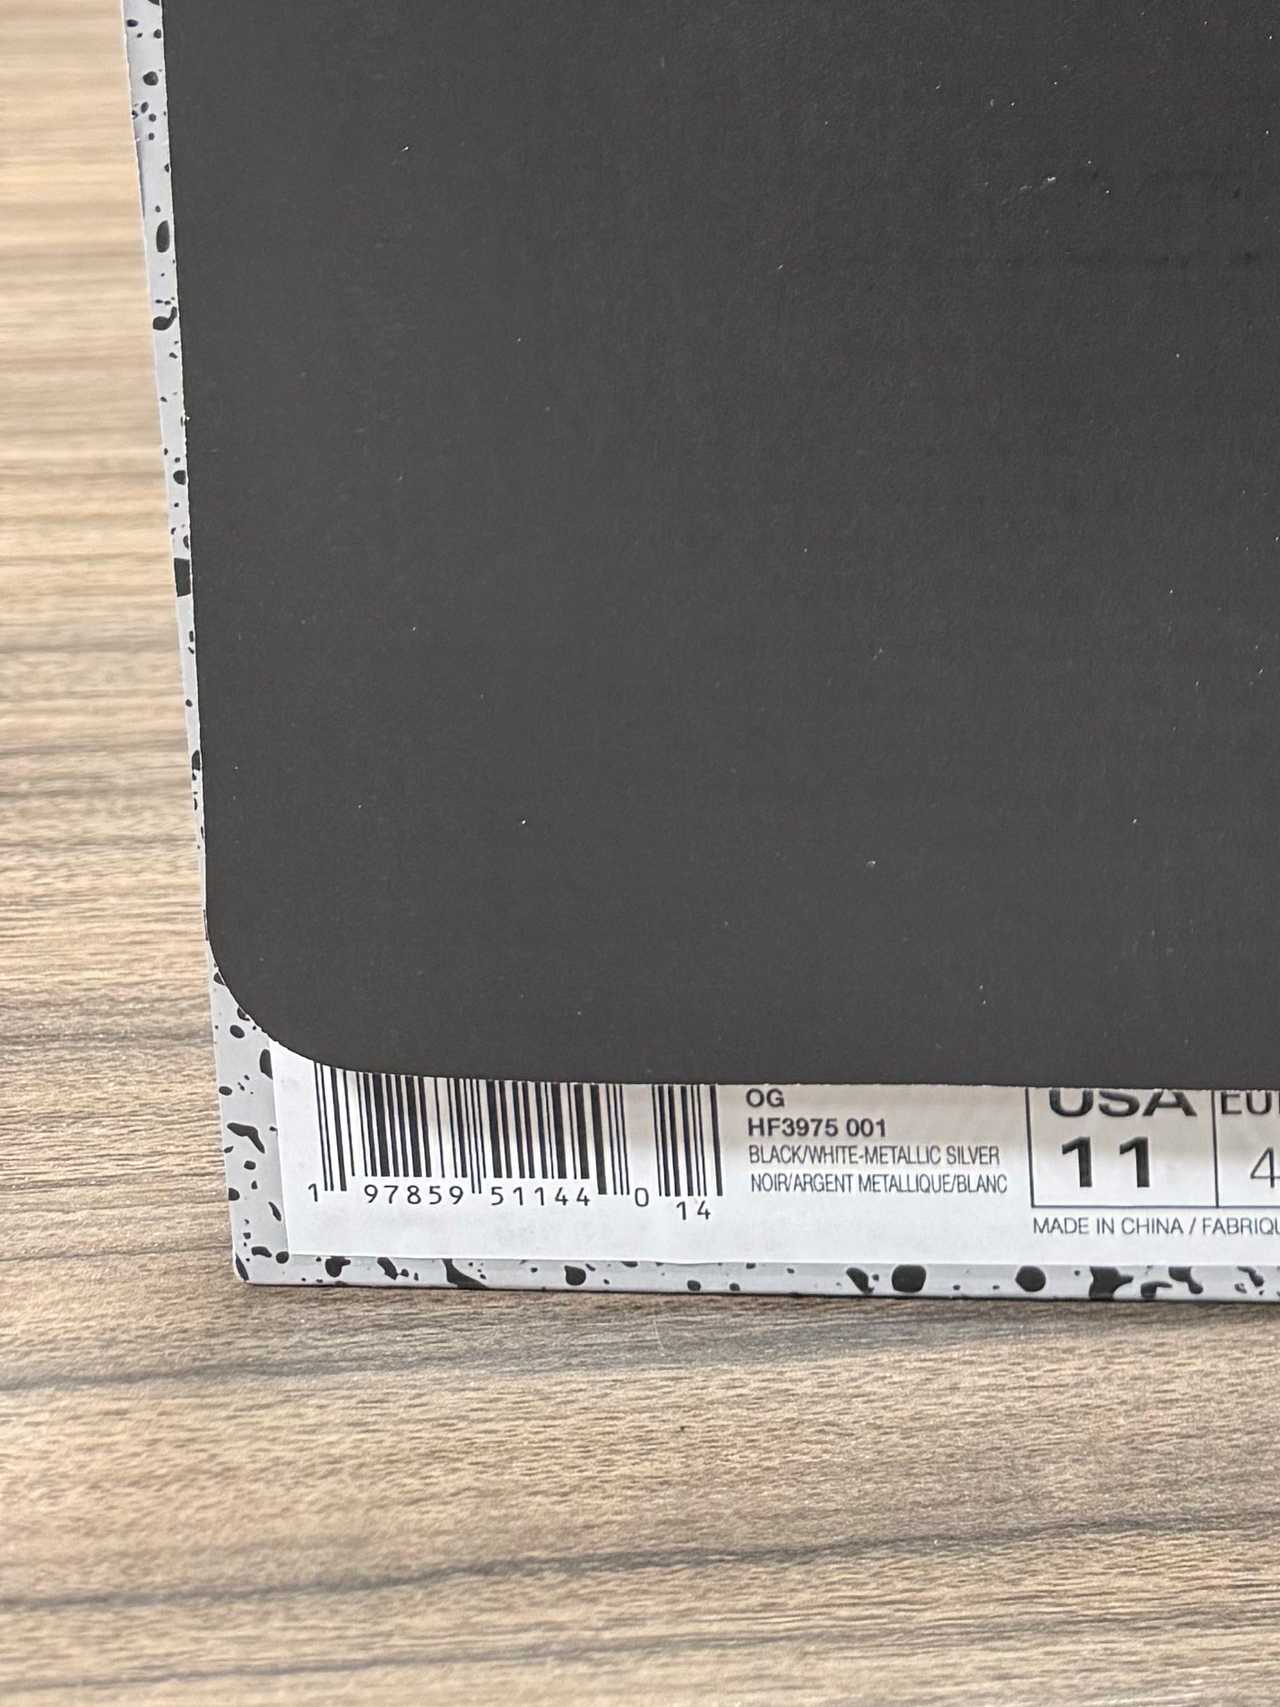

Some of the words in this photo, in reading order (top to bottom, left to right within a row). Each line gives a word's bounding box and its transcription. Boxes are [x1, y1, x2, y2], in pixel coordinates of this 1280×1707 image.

[745, 1088, 785, 1109] OG
[747, 1117, 839, 1139] HF3975
[845, 1117, 887, 1138] 001
[748, 1143, 942, 1166] BLACK/WHITE-METALLIC
[946, 1145, 1001, 1166] SILVER
[1061, 1136, 1151, 1188] 11
[750, 1172, 854, 1193] NOIR/ARGENT
[858, 1173, 1009, 1194] METALLIQUE/BLANC
[307, 1183, 320, 1203] 1
[363, 1184, 465, 1206] 97859
[490, 1186, 592, 1207] 51144
[634, 1187, 651, 1208] 0
[674, 1194, 712, 1221] 14
[1033, 1217, 1089, 1235] MADE
[1096, 1217, 1115, 1235] IN
[1121, 1217, 1184, 1236] CHINA
